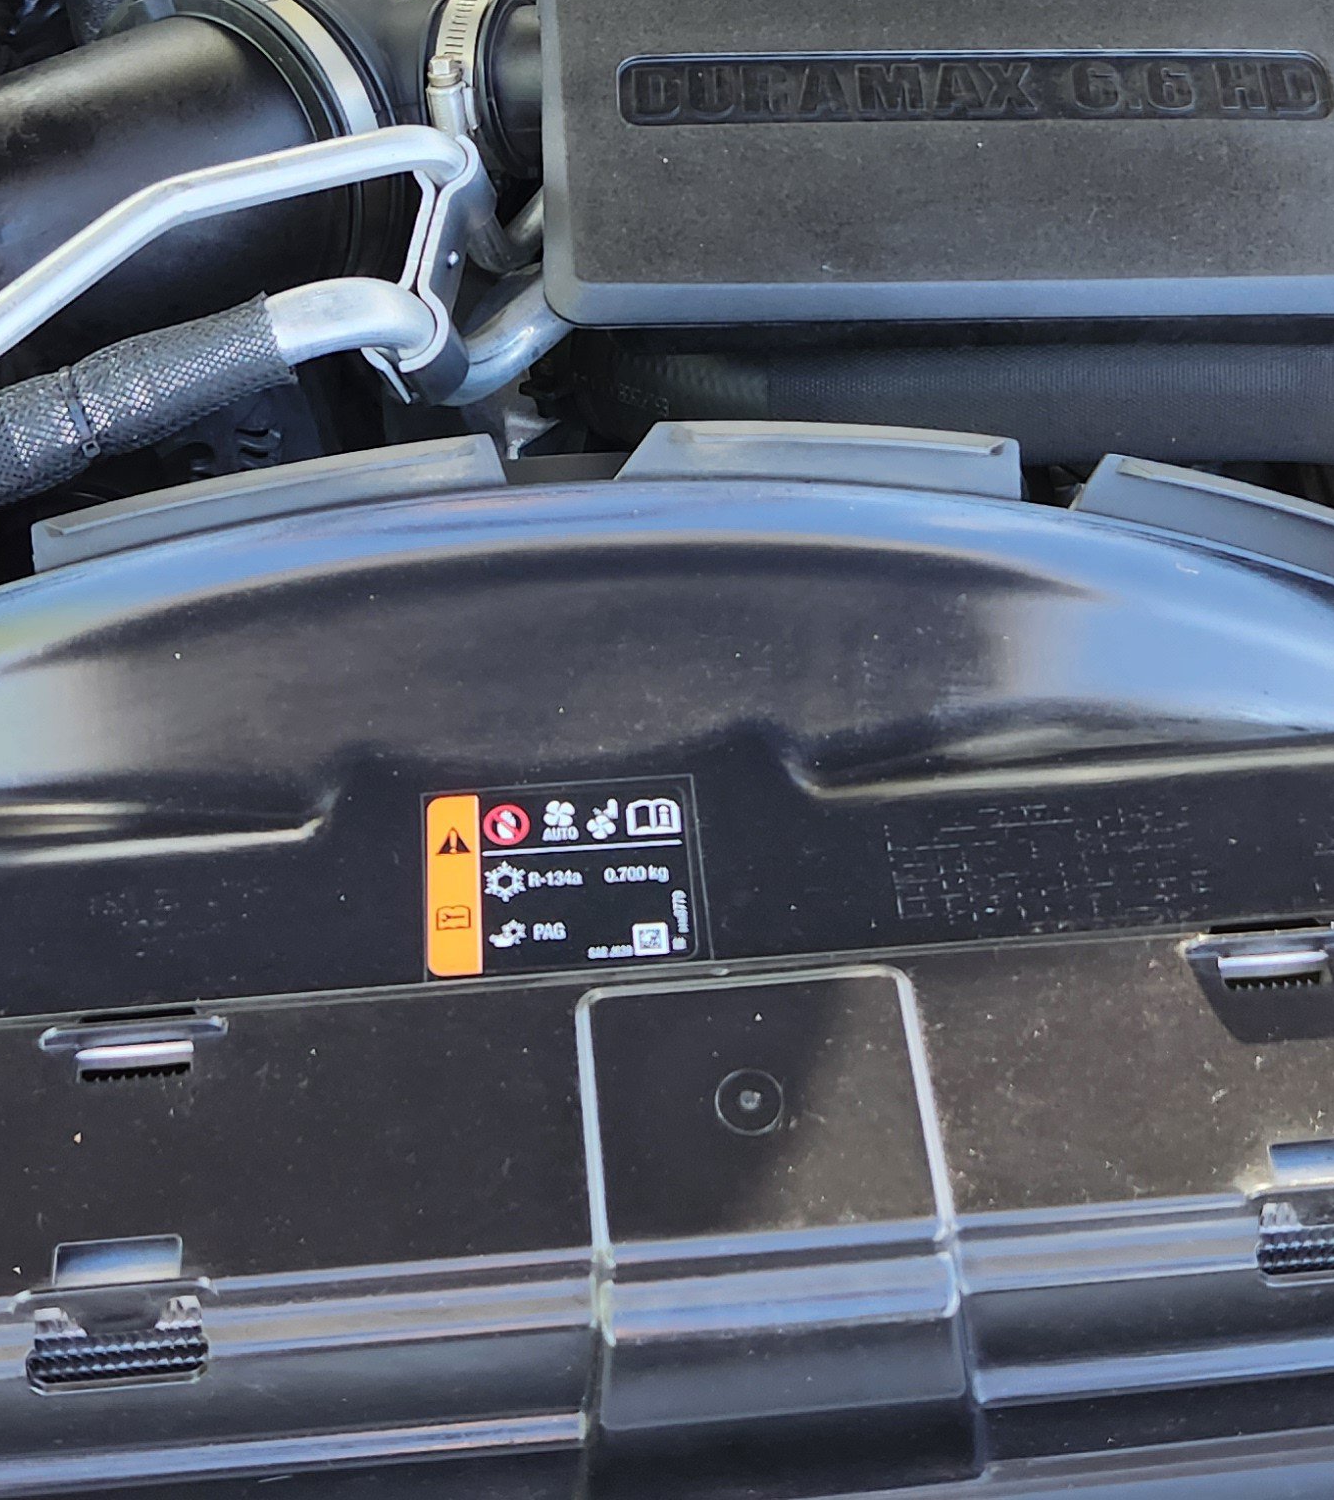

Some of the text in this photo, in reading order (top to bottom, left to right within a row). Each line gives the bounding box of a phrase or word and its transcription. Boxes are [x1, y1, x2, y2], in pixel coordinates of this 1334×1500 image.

[631, 62, 1319, 119] DURAMAX 6.6 HD
[542, 826, 579, 842] AUTO
[528, 864, 669, 888] R-134a 0.700 kg
[533, 922, 567, 941] PAG
